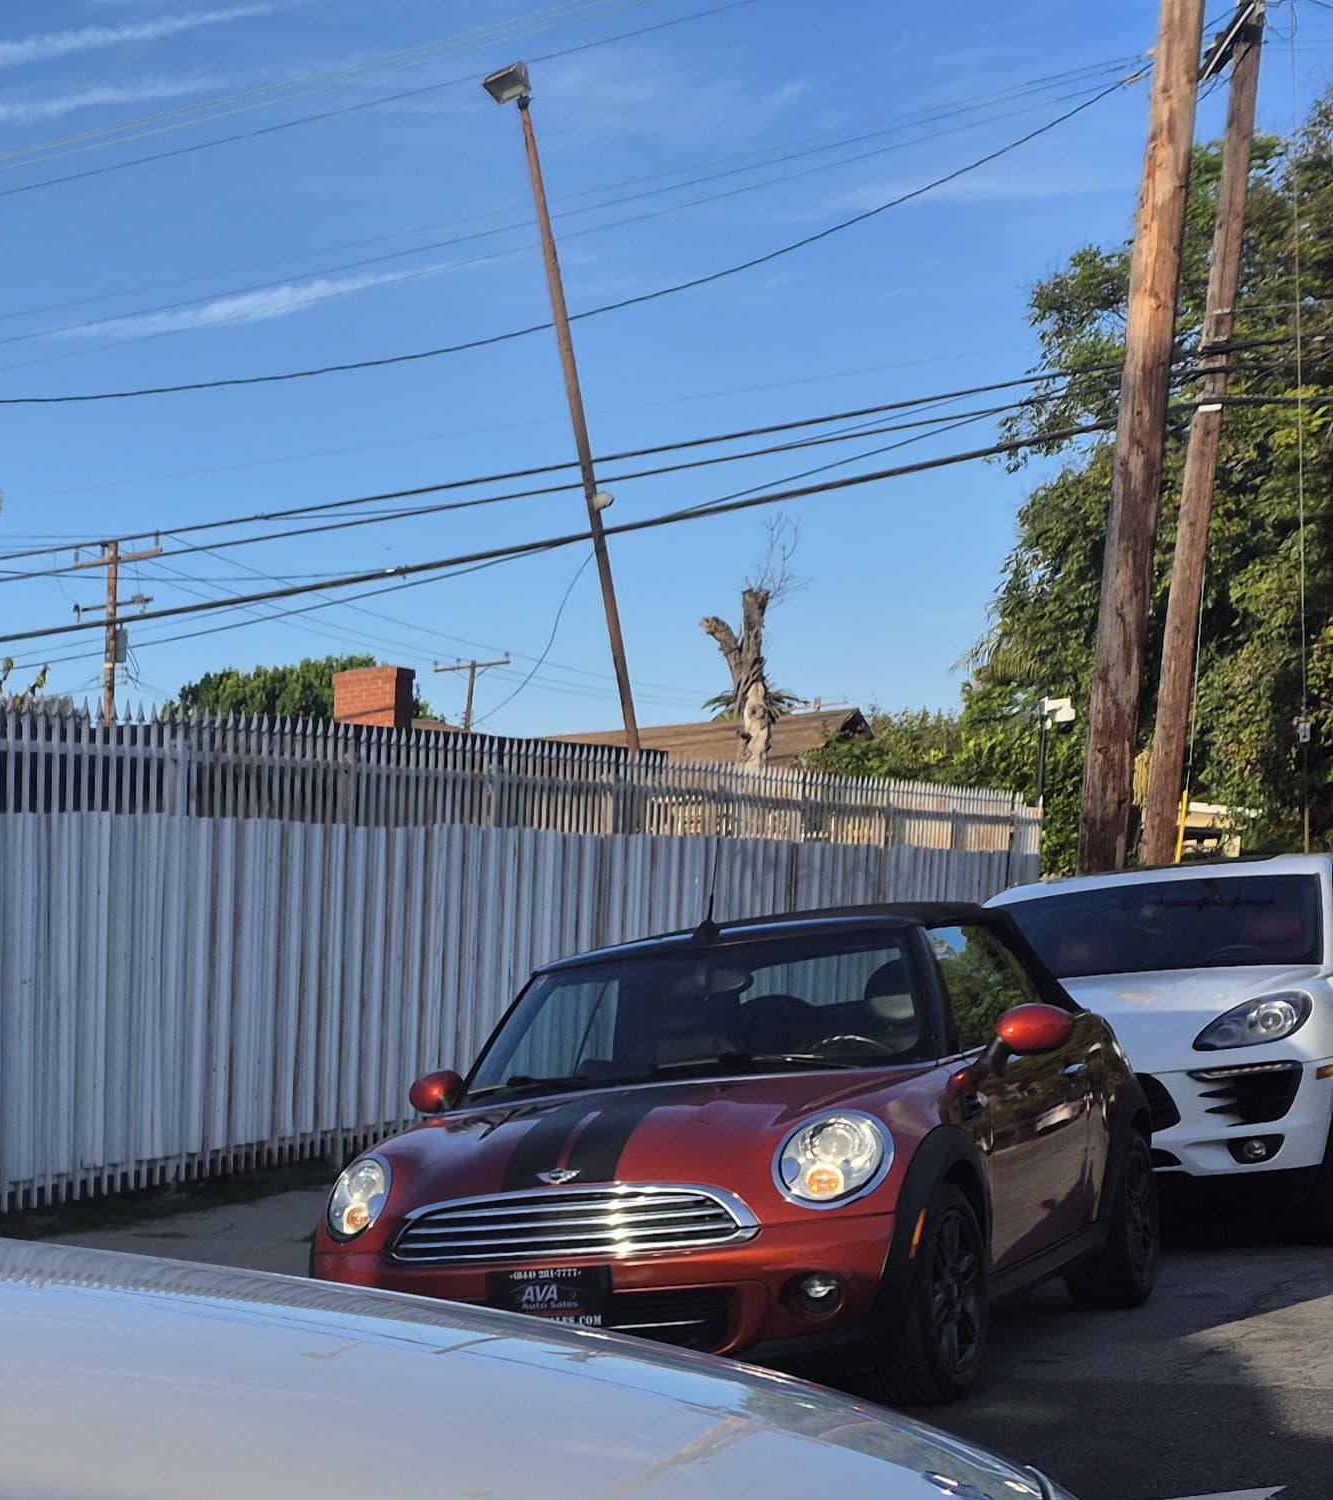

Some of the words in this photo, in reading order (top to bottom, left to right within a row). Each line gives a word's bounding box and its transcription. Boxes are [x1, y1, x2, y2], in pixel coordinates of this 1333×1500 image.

[521, 1283, 558, 1302] AVA
[521, 1301, 548, 1310] Auto
[549, 1300, 579, 1309] Sales
